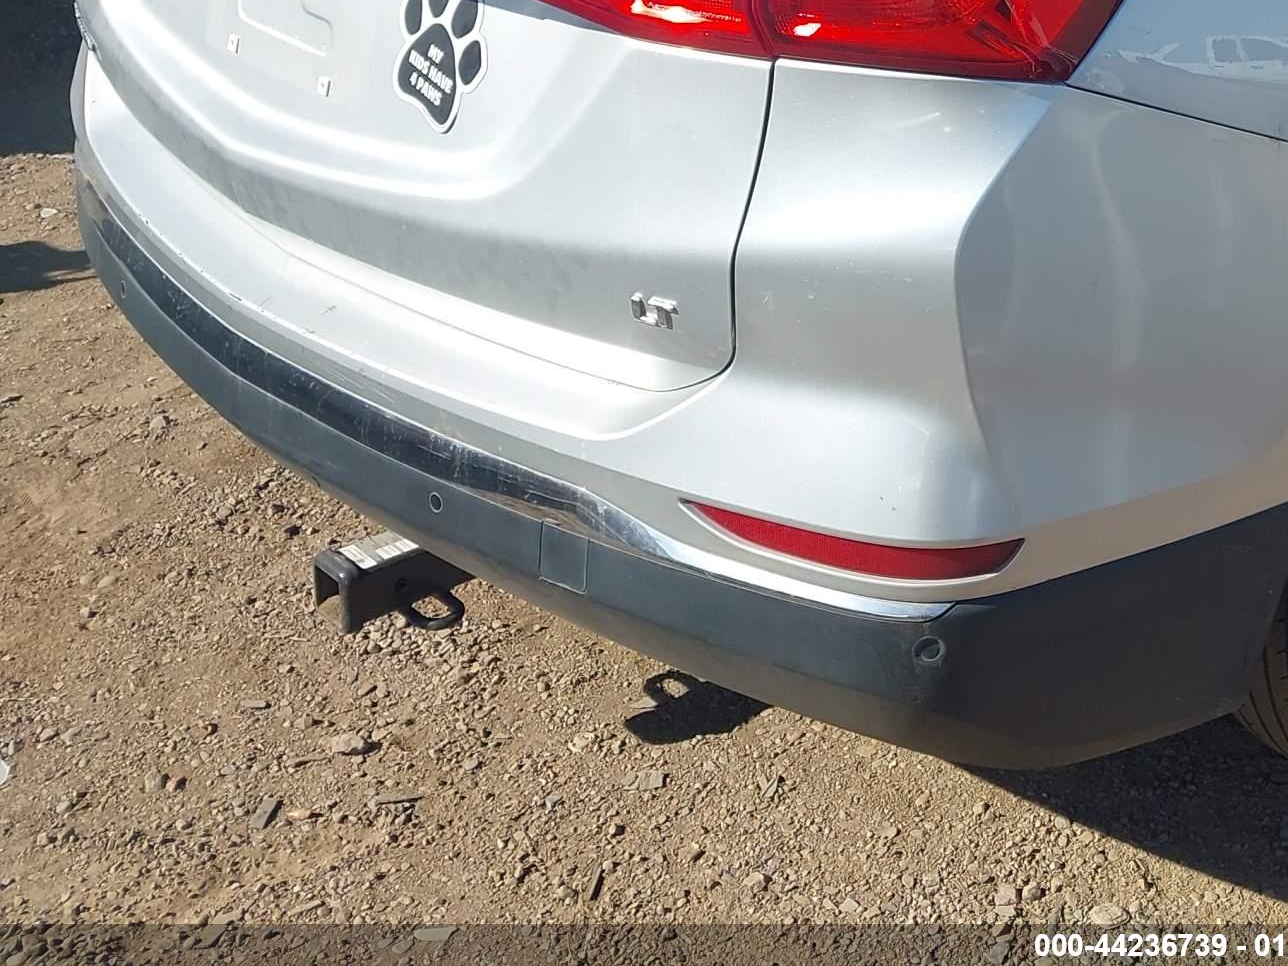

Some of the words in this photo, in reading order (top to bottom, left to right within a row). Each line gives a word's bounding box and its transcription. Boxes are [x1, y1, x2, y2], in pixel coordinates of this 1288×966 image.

[409, 49, 430, 75] KIDS
[428, 65, 453, 94] HAVE
[428, 44, 444, 64] MY
[410, 71, 418, 86] 4
[415, 76, 442, 106] PAWS
[630, 292, 680, 331] LT
